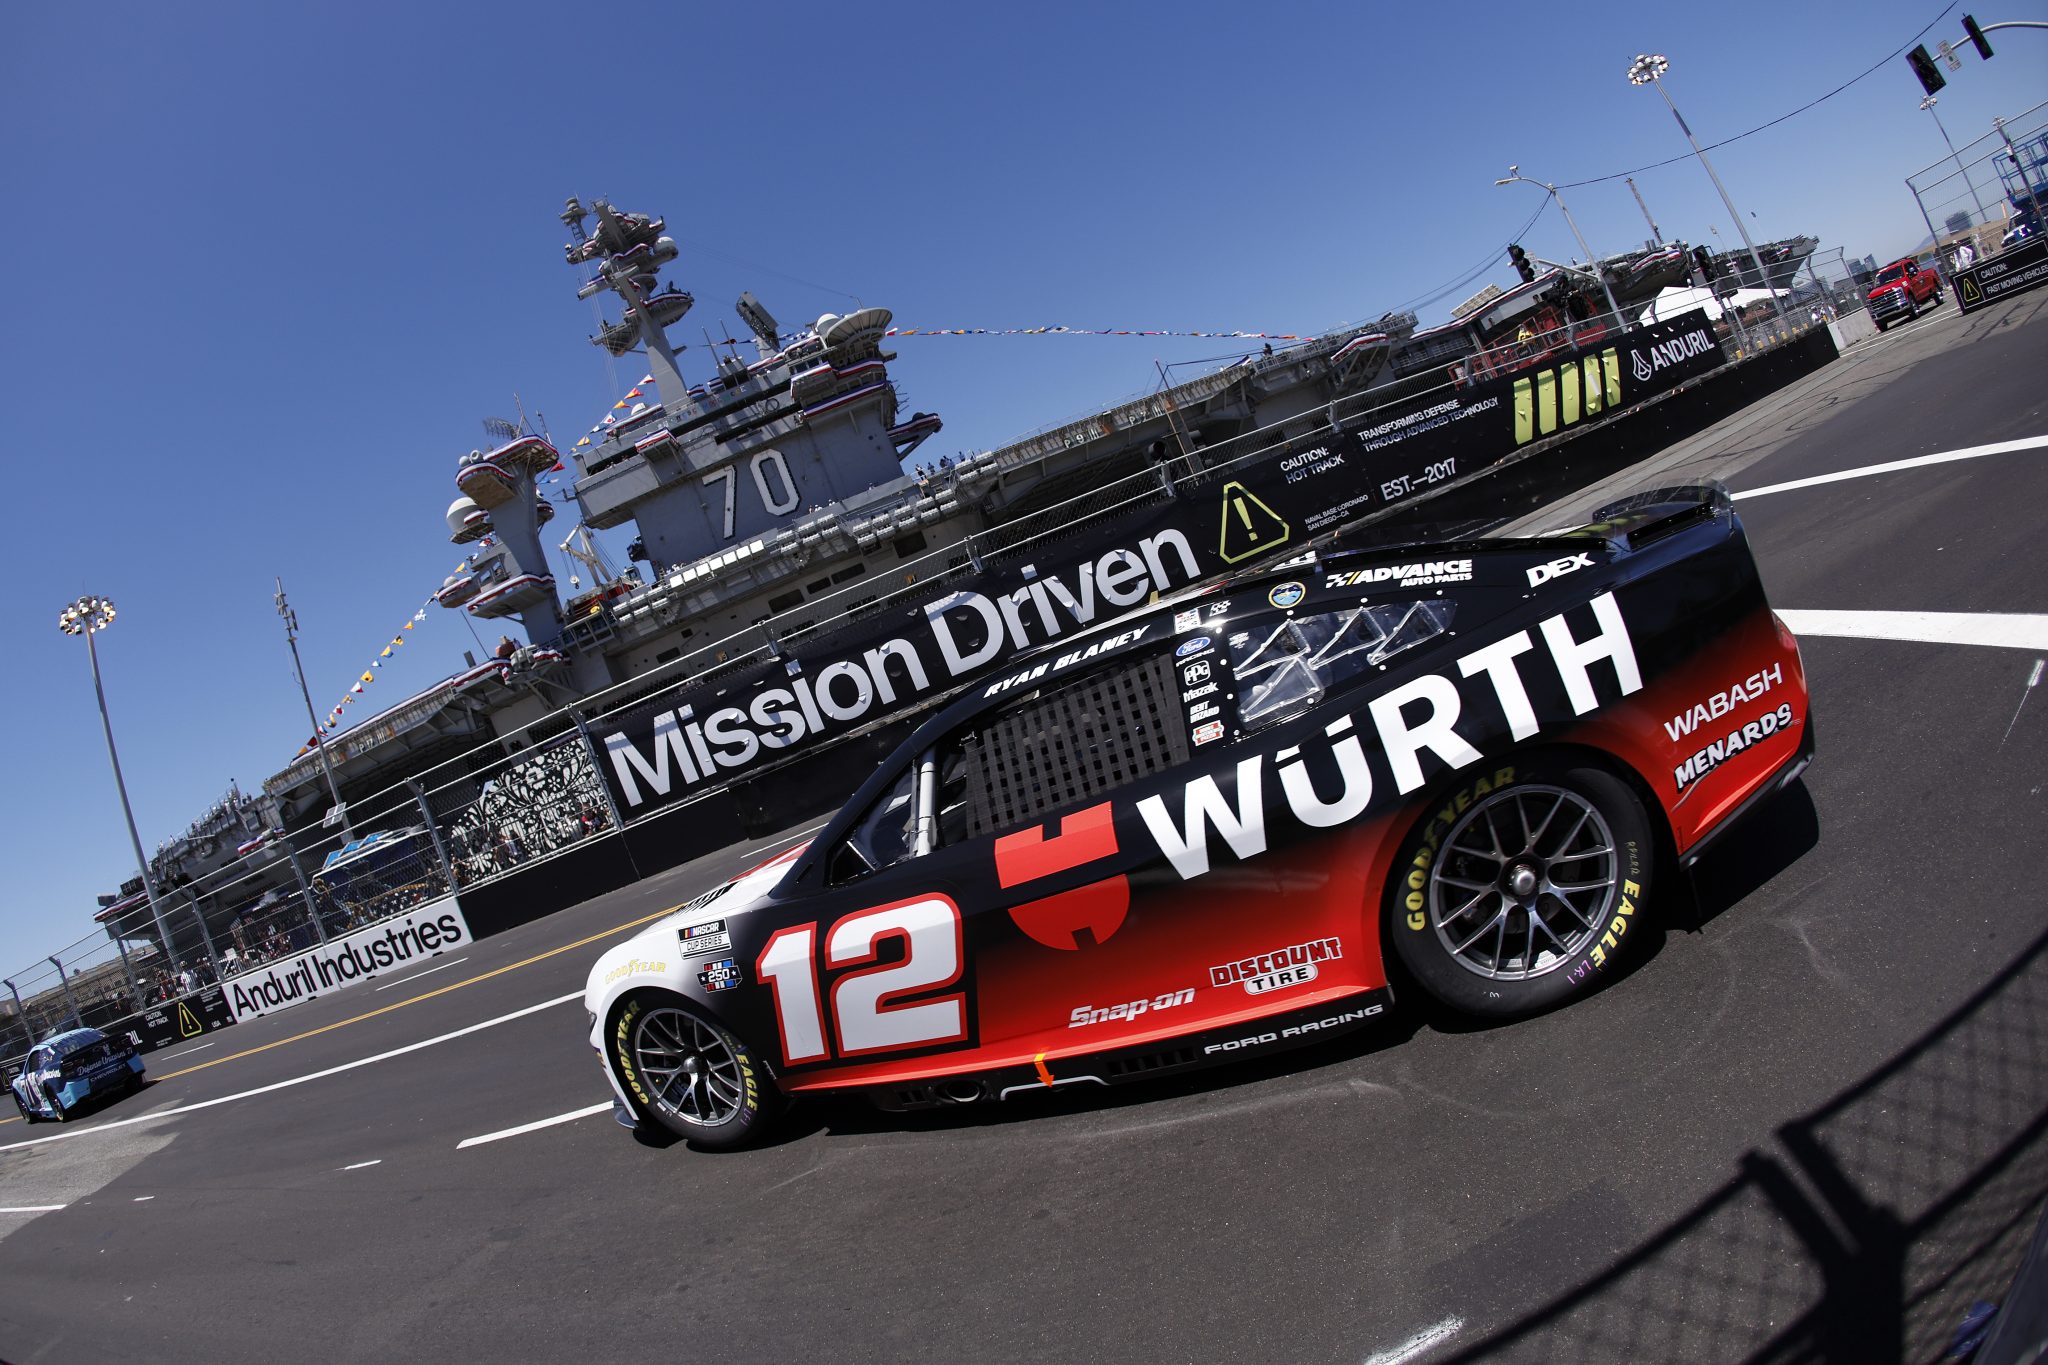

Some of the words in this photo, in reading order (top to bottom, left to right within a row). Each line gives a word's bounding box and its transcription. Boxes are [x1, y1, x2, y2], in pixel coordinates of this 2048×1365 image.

[1987, 283, 2001, 294] FAST
[2001, 275, 2024, 289] MOVING
[1652, 326, 1716, 372] ANDURIL
[1358, 413, 1425, 441] TRANSFORMING
[1424, 399, 1461, 418] DEFENSE
[1363, 432, 1406, 453] THROUGH
[1407, 415, 1449, 438] ADVANCED
[1449, 396, 1499, 422] TECHNOLOGY
[1280, 447, 1330, 472] CAUTION:
[1286, 467, 1309, 485] HOT
[1310, 453, 1345, 475] TRACK
[702, 448, 800, 540] 70
[1305, 513, 1323, 525] NAVAL
[1322, 506, 1338, 517] BASE
[1337, 494, 1369, 512] CORONADO
[1307, 521, 1320, 531] SAN
[1353, 559, 1473, 585] ADVANCE
[1400, 573, 1433, 588] AUTO
[1434, 571, 1473, 584] PARTS
[1526, 552, 1596, 588] DEX
[983, 668, 1049, 699] RYAN
[1052, 625, 1151, 673] BLANEY
[1176, 648, 1215, 667] RACING
[1182, 640, 1205, 655] Ford
[603, 636, 930, 807] Mission
[924, 528, 1202, 677] Driven
[1186, 662, 1210, 682] PPG
[1183, 681, 1220, 703] Mazak
[1190, 701, 1210, 715] DENT
[1664, 662, 1783, 743] WABASH
[1190, 706, 1220, 724] WIZARD
[1136, 591, 1643, 880] WÜRTH
[1674, 703, 1793, 790] MENARDS
[1406, 765, 1518, 932] GOODYEAR
[693, 921, 720, 937] NASCAR
[1589, 878, 1641, 968] EAGLE
[687, 939, 699, 951] CUP
[700, 935, 723, 949] SERIES
[232, 958, 314, 1017] Anduril
[312, 914, 462, 987] Industries
[604, 959, 666, 985] GOODYEAR
[708, 969, 730, 982] 250
[756, 892, 968, 1067] 12
[1209, 936, 1343, 988] DISCOUNT
[1252, 968, 1310, 992] TIRE
[1068, 988, 1195, 1028] Snap-on
[1204, 1031, 1278, 1054] FORD
[1281, 1004, 1384, 1039] RACING
[617, 1000, 650, 1105] GOODYEAR
[736, 1054, 758, 1111] EAGLE
